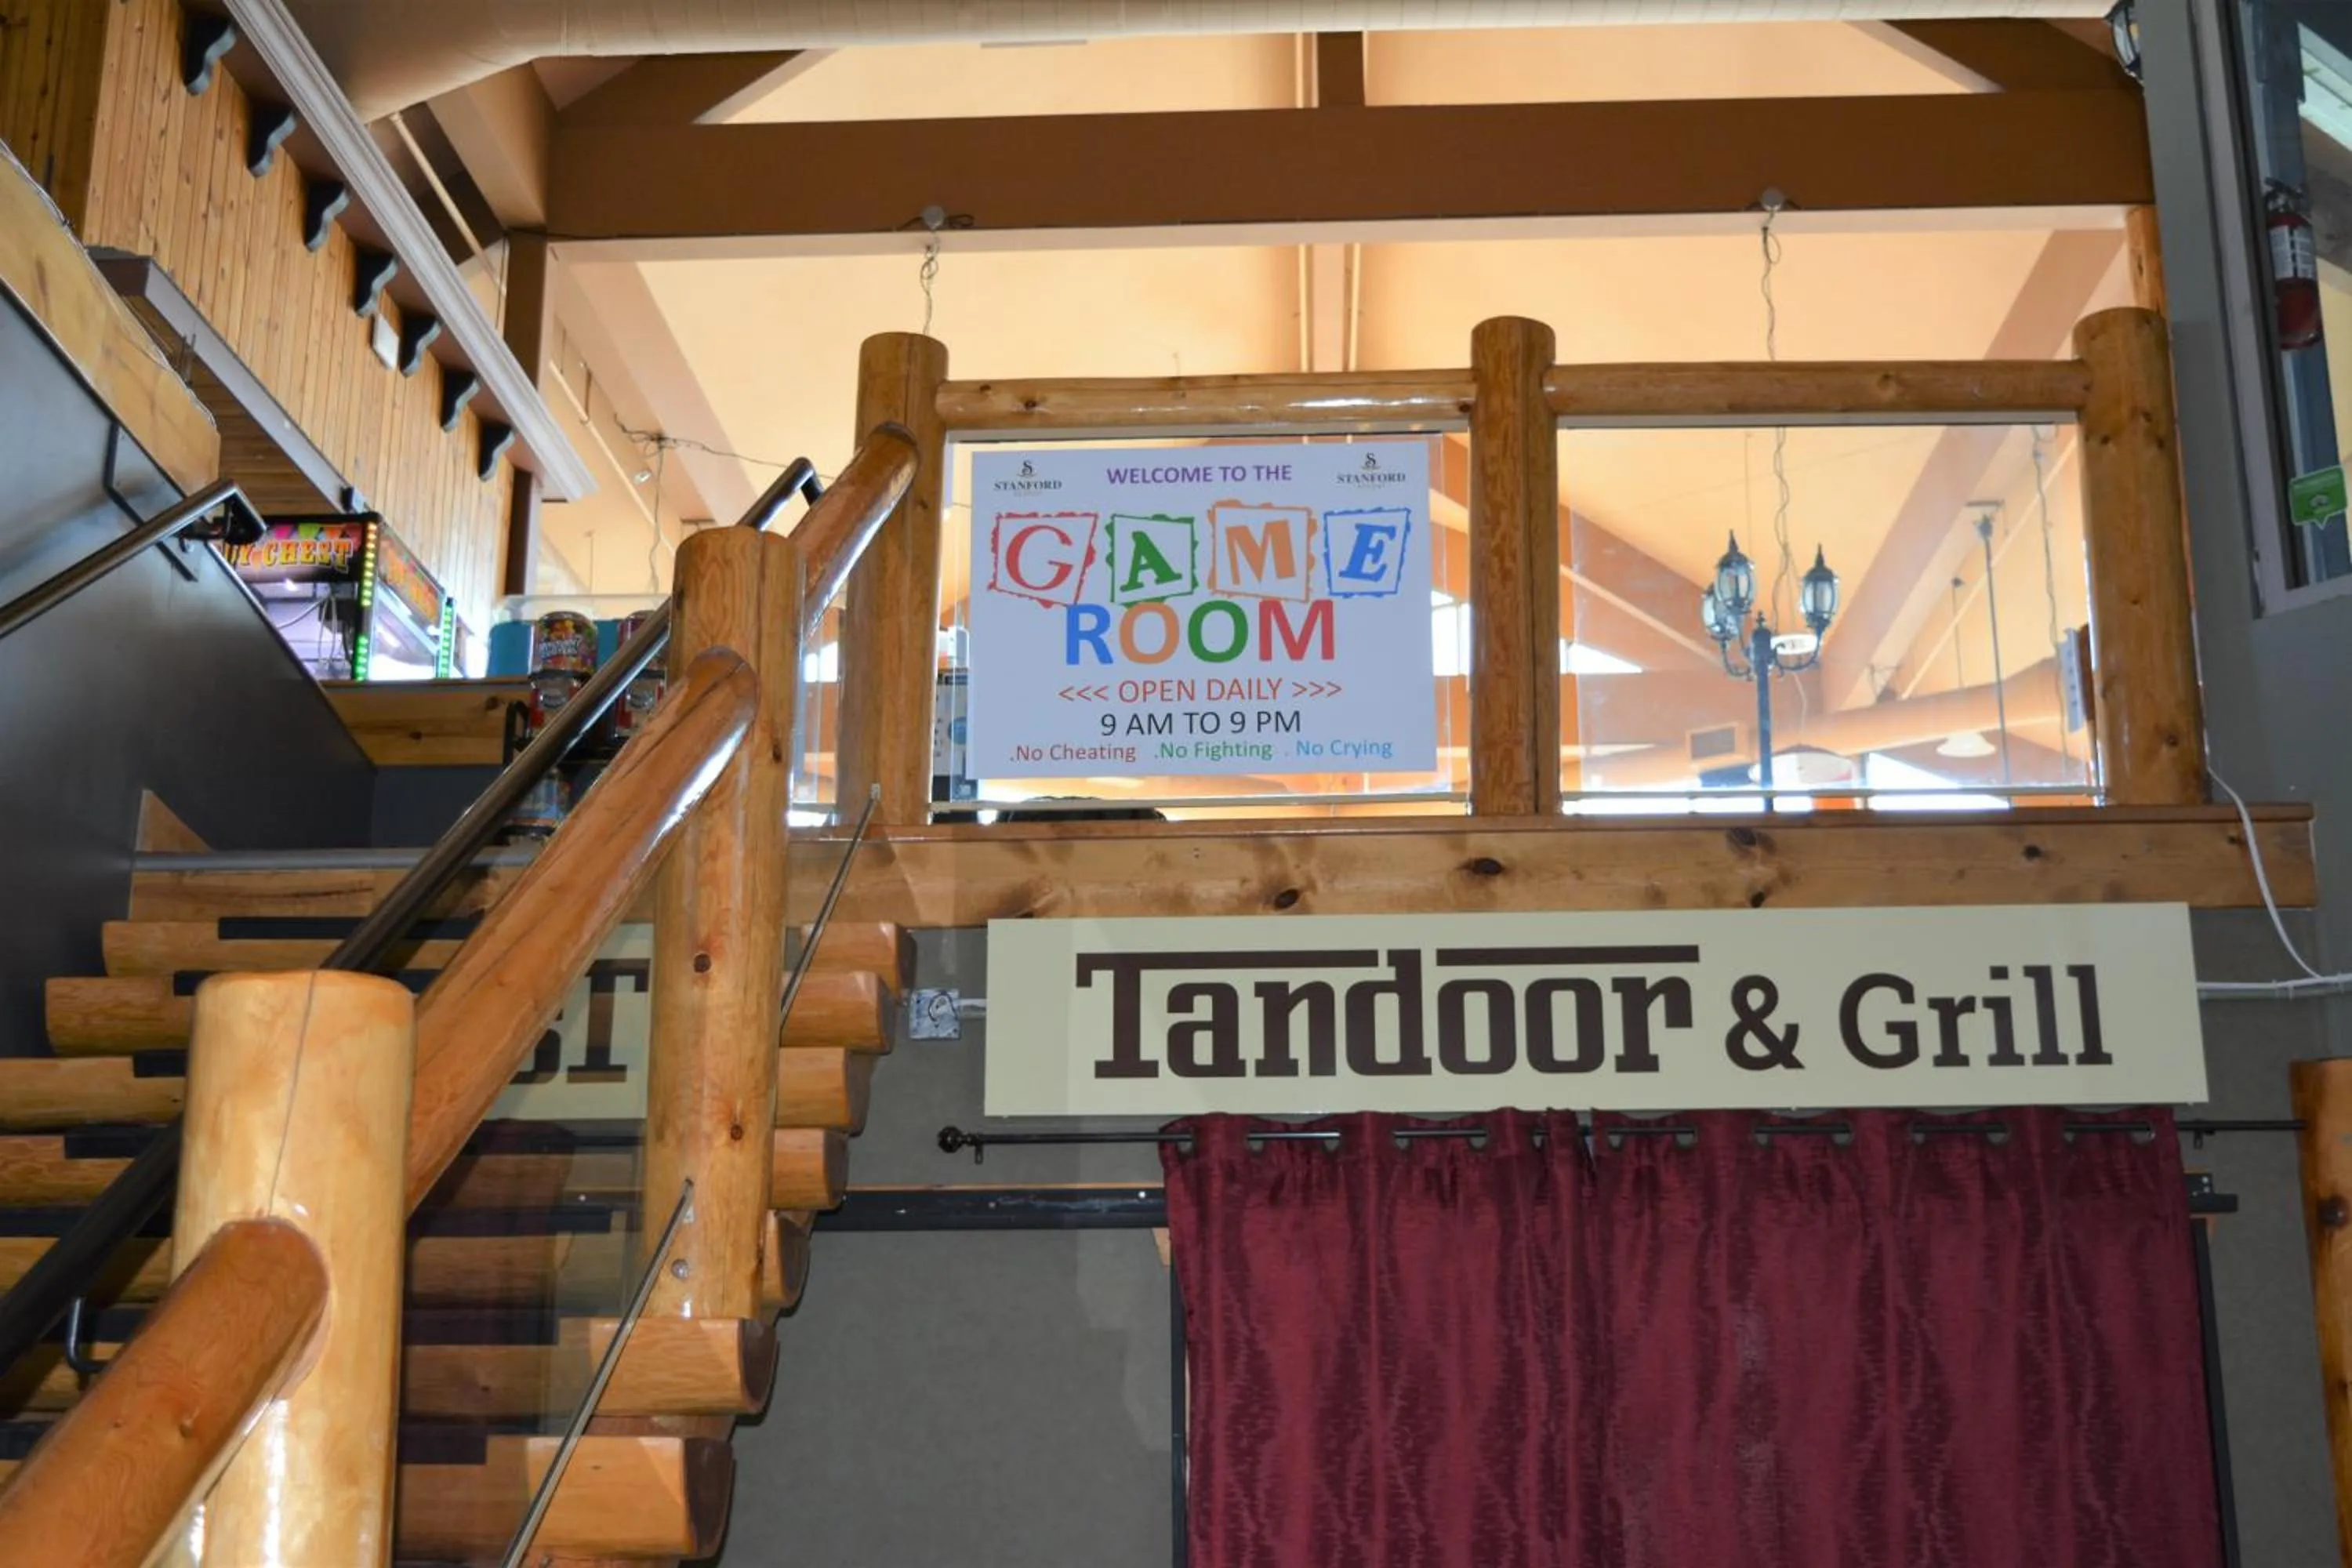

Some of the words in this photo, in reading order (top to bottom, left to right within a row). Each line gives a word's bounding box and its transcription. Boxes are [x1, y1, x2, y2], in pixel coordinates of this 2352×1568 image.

[993, 479, 1063, 492] STANFORD
[1106, 466, 1214, 485] WELCOME
[1218, 465, 1247, 483] TO
[1252, 463, 1293, 482] THE
[1335, 472, 1406, 485] STANFORD
[263, 539, 352, 572] CHEST
[1004, 517, 1399, 594] GAME
[1065, 598, 1336, 666] ROOM
[1118, 678, 1196, 704] OPEN
[1206, 677, 1283, 702] DAILY
[1101, 713, 1117, 737] 9
[1126, 712, 1174, 737] AM
[1182, 710, 1221, 735] TO
[1229, 710, 1247, 735] 9
[1256, 710, 1301, 735] PM
[1049, 743, 1138, 763] Cheating
[1194, 739, 1274, 762] Fighting
[1330, 739, 1394, 760] Crying
[1076, 944, 1701, 1080] Tandoor
[1725, 974, 1806, 1072] &
[1838, 964, 2114, 1069] Grill
